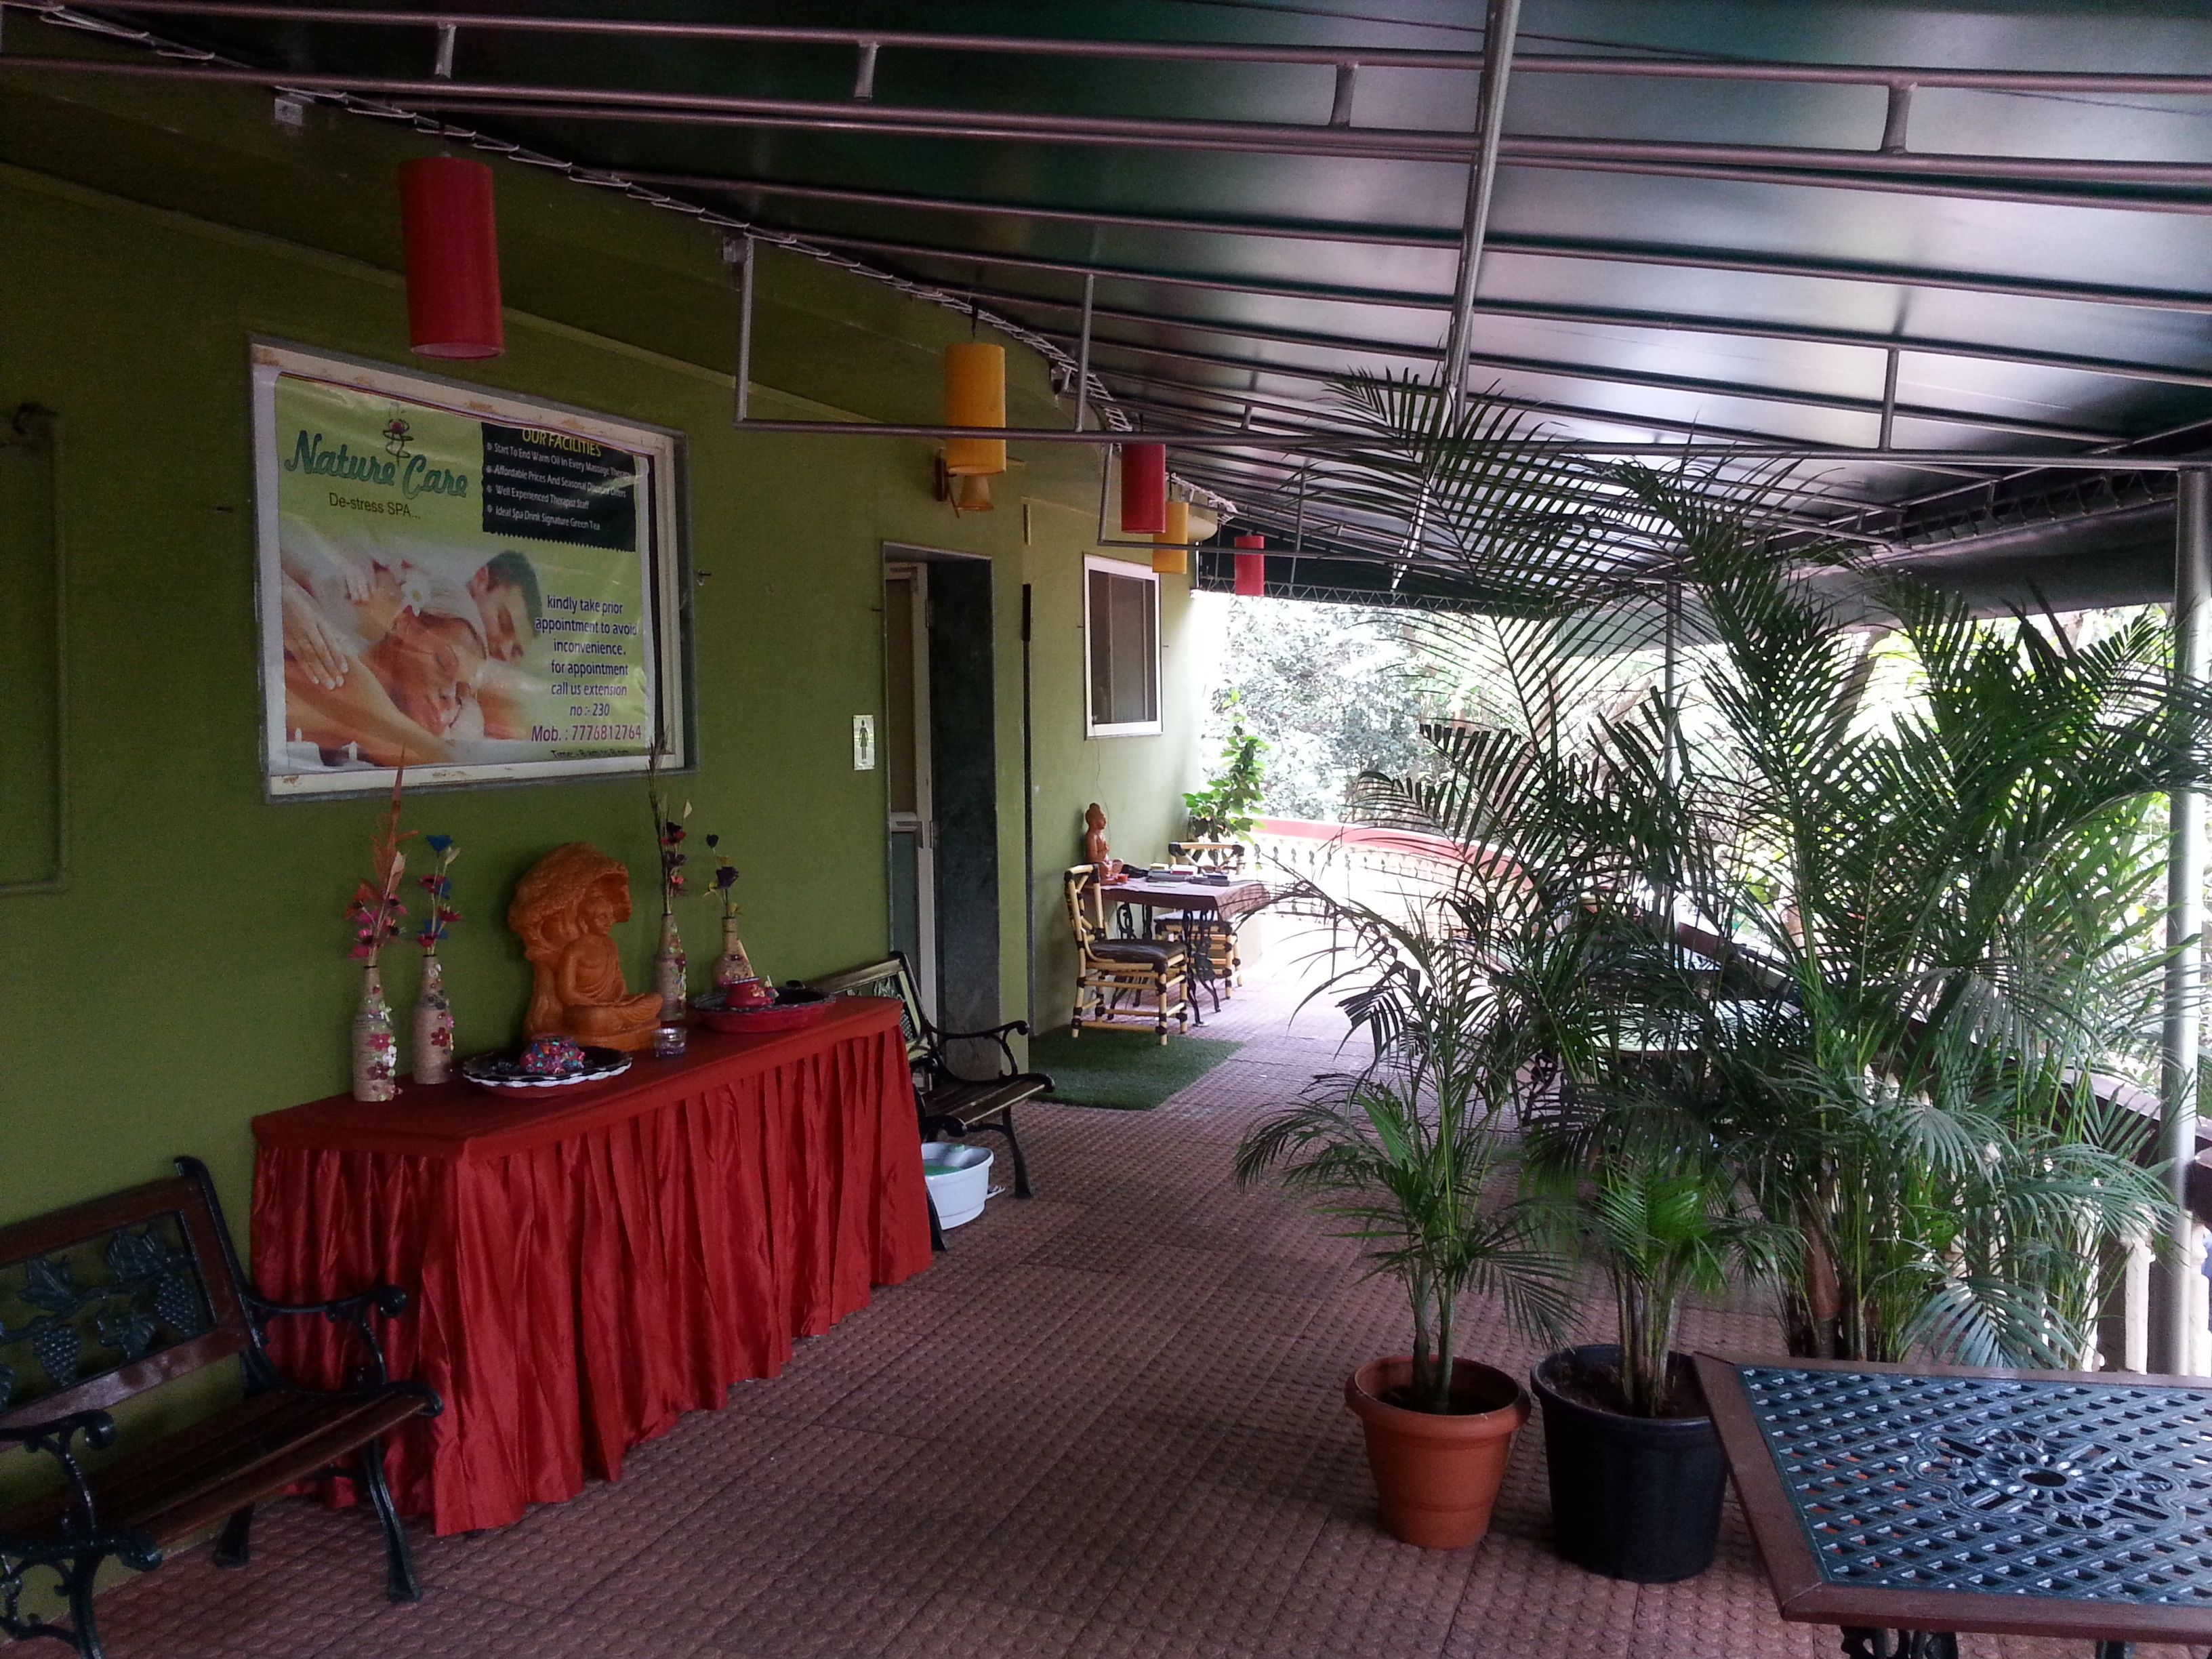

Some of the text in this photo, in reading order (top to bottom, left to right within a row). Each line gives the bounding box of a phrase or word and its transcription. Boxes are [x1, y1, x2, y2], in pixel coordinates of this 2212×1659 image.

[522, 428, 602, 457] OUR FACILITIES
[284, 430, 469, 499] Nature Care
[494, 443, 509, 455] Start
[510, 446, 518, 457] To
[518, 448, 531, 459] End
[531, 451, 550, 463] Warm
[550, 455, 560, 466] Oil
[561, 457, 569, 468] In
[569, 457, 586, 473] Every
[493, 464, 528, 480] Affordable
[528, 470, 546, 483] Prices
[547, 474, 561, 486] And
[560, 476, 587, 490] Seasonal
[329, 492, 421, 520] De-stress SPA...
[495, 484, 590, 510] Well Experienced Therapist Staff
[495, 505, 600, 531] Ideal Spa Drink Signature Green Tea
[548, 595, 623, 616] kindly take prior
[535, 617, 638, 636] appointment to avoid
[553, 638, 626, 655] inconvenience.
[551, 659, 629, 678] for appointment
[551, 682, 628, 696] call us extension
[592, 703, 610, 716] 230
[531, 724, 561, 742] Mob.
[571, 724, 642, 741] 7776812764
